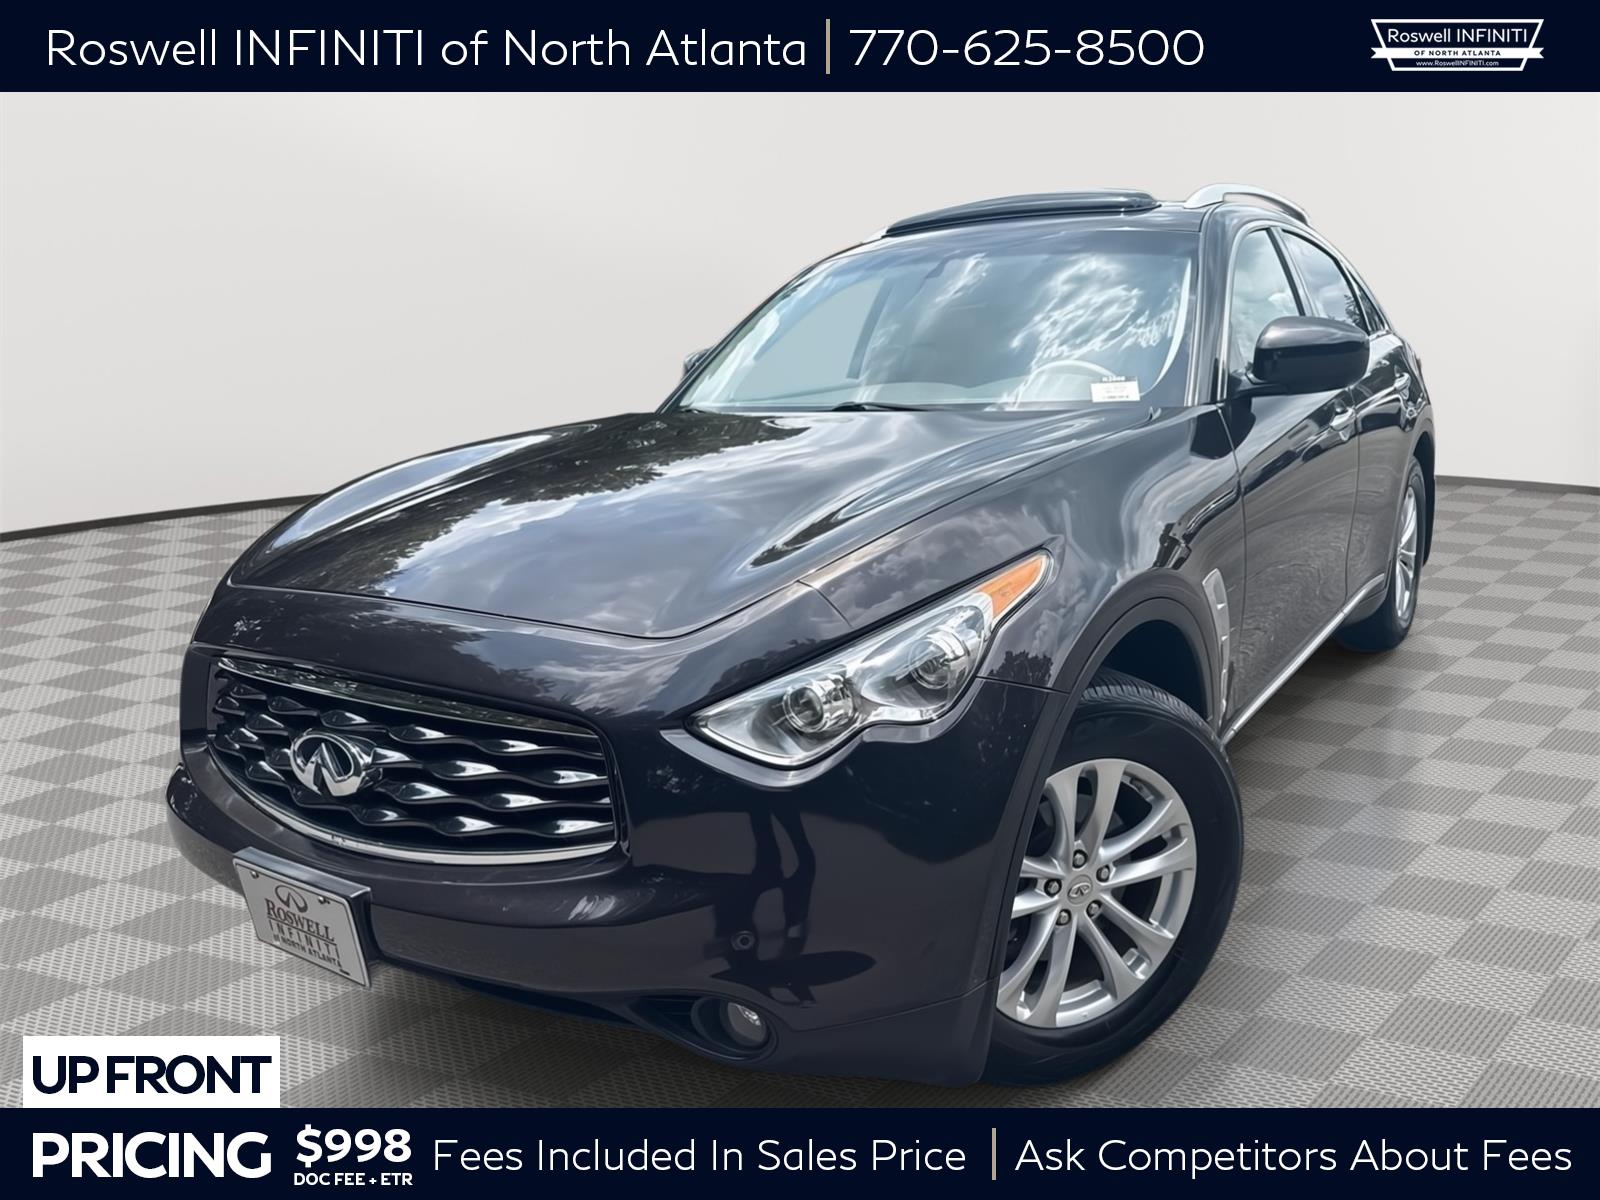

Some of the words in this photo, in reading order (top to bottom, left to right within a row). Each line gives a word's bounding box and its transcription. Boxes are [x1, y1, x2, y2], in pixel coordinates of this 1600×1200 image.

[265, 898, 334, 942] ROSWELL
[269, 920, 341, 959] INFINITI
[281, 936, 307, 953] NORTH
[308, 948, 342, 968] ATLANTA
